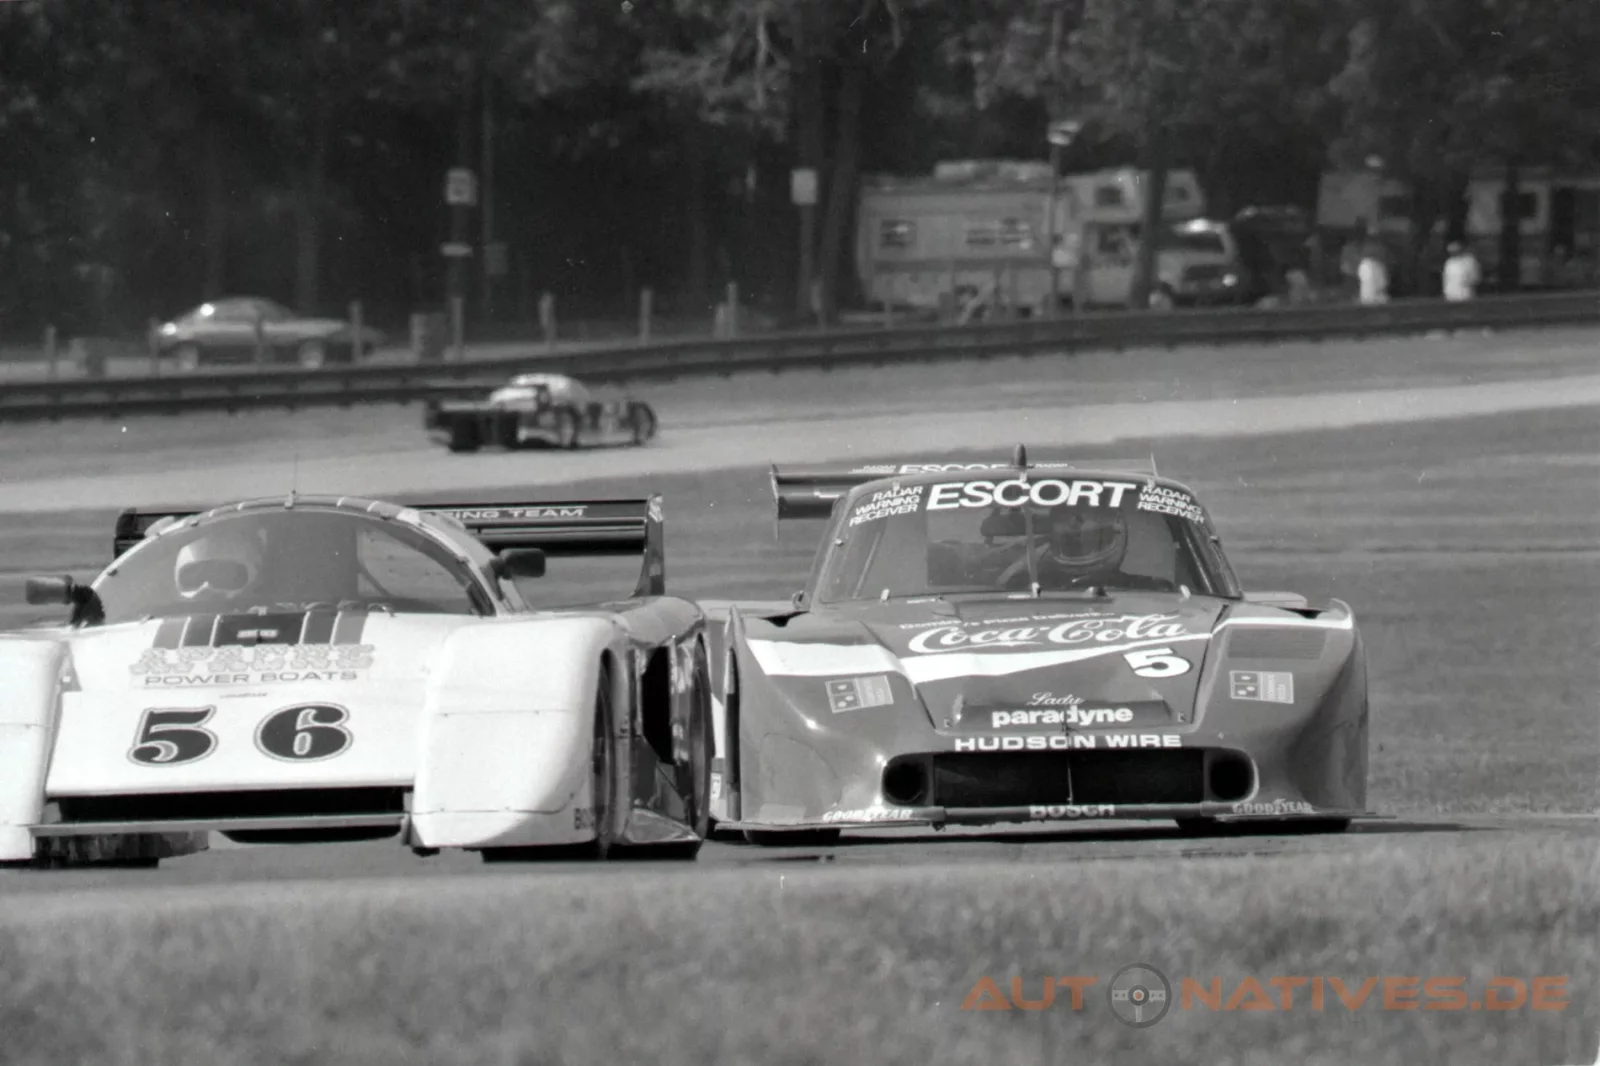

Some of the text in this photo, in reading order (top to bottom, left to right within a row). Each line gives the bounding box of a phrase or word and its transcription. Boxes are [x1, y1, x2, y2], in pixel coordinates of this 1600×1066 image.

[872, 486, 923, 502] RADAR
[926, 479, 1136, 510] ESCORT
[1140, 493, 1202, 514] WARNING
[1142, 485, 1190, 503] RADAR
[506, 508, 584, 518] TEAM
[848, 503, 918, 527] RECEIVER
[856, 495, 920, 515] WARNING
[1137, 501, 1204, 523] RECEIVER
[908, 614, 1188, 653] Coca-Cola
[1123, 648, 1191, 678] 5
[144, 670, 358, 686] POWER BOATS
[992, 705, 1134, 728] paradyne
[954, 734, 1183, 751] HUDSON WIRE
[1029, 804, 1116, 819] BOSCH
